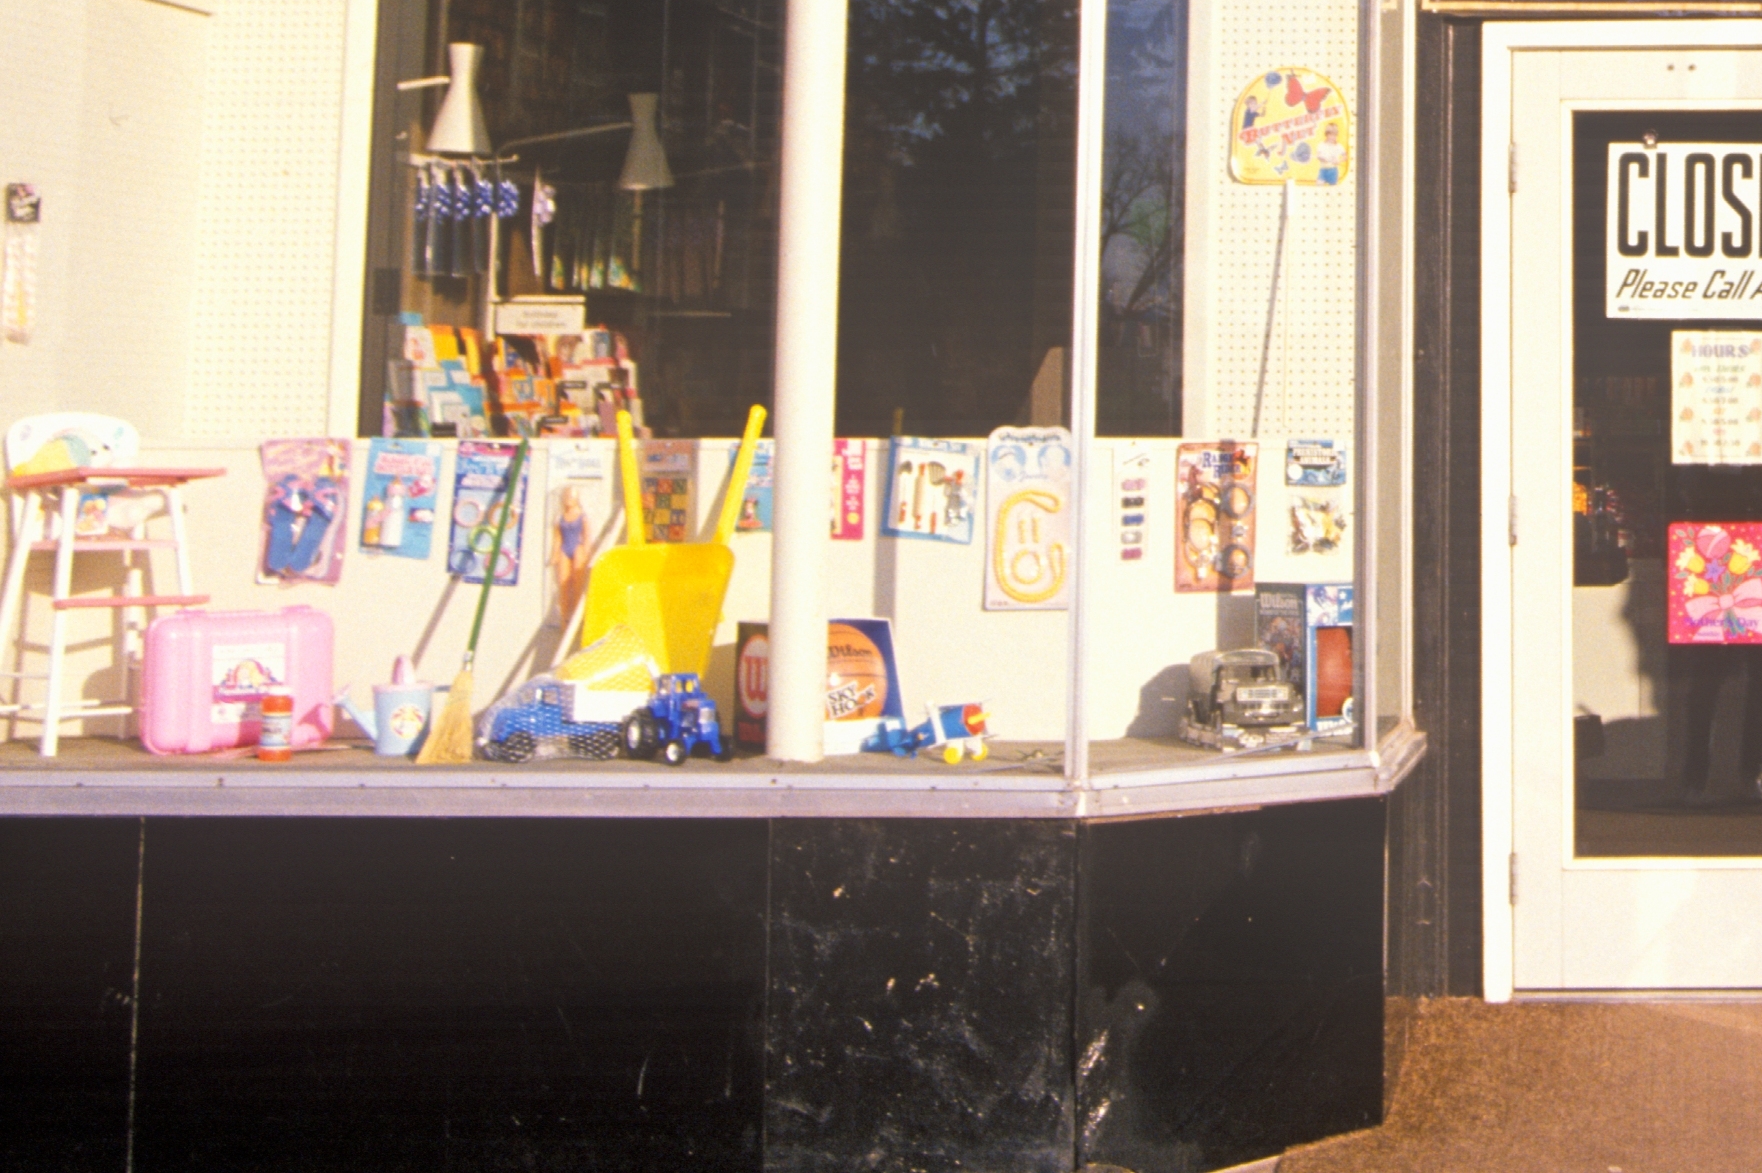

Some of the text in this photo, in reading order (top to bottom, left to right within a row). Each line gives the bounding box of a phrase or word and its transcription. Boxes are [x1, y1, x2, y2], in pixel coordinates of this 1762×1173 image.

[1616, 269, 1698, 298] Please
[1702, 270, 1755, 300] Call
[1692, 344, 1751, 358] HOURS
[827, 684, 857, 702] SKY
